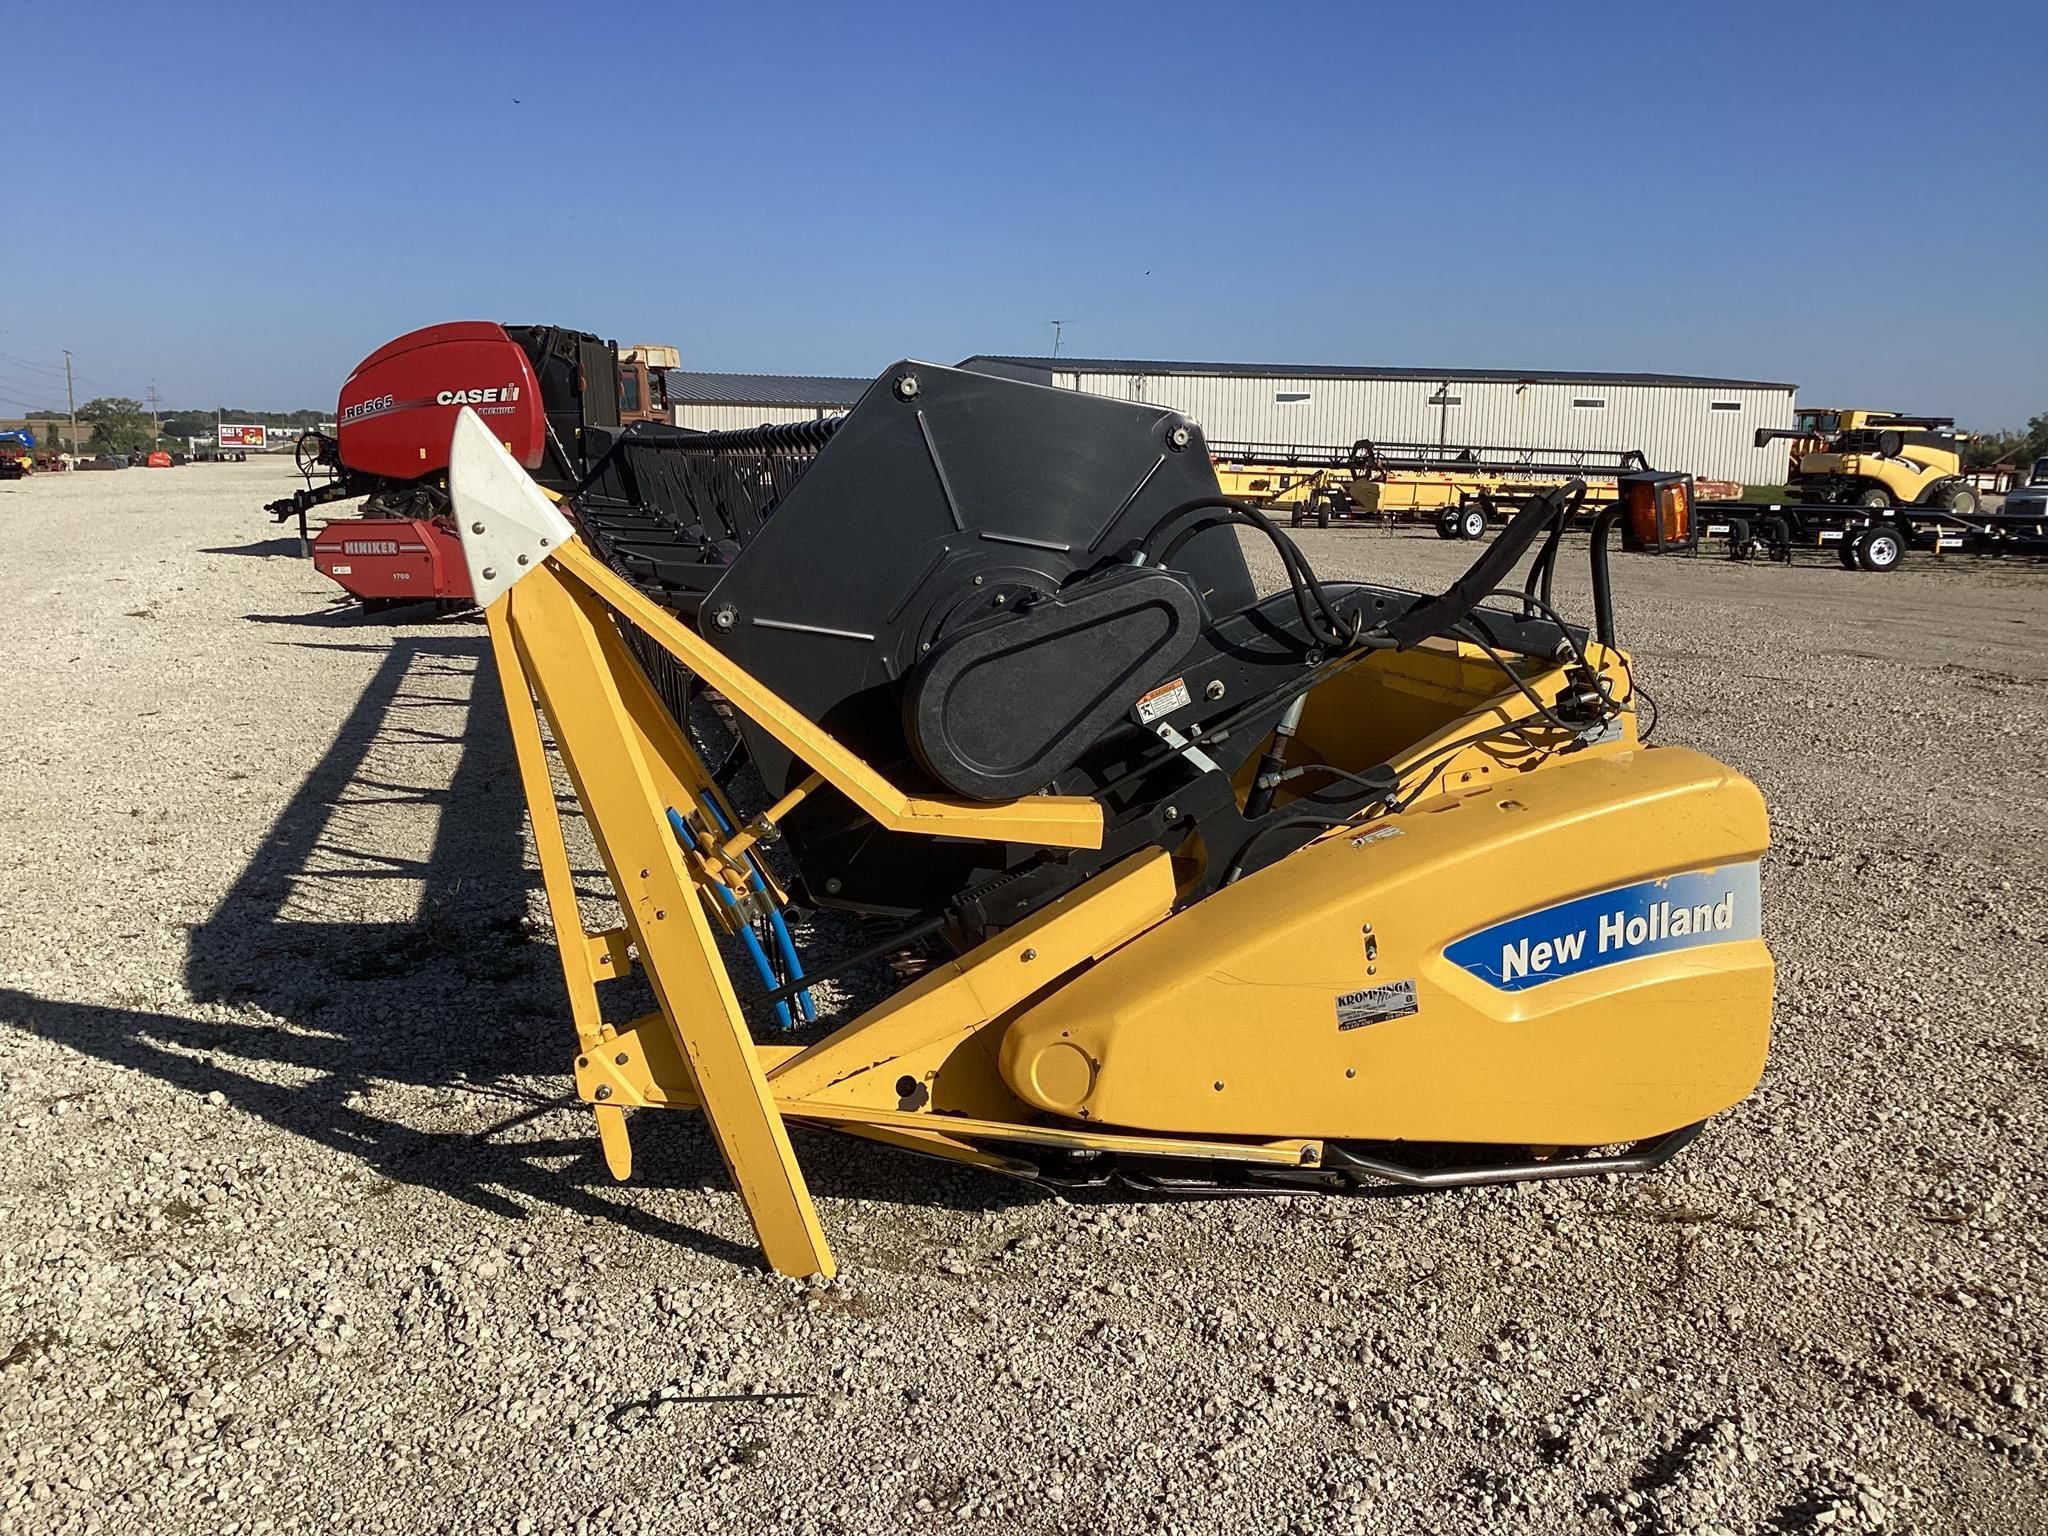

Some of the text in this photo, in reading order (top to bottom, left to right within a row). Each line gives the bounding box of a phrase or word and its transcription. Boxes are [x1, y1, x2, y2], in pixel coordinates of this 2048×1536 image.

[436, 388, 498, 405] CASE
[345, 394, 394, 419] RB565
[477, 406, 515, 416] PREMIUM
[344, 541, 397, 554] HINIKER
[1502, 892, 1734, 983] New Holland
